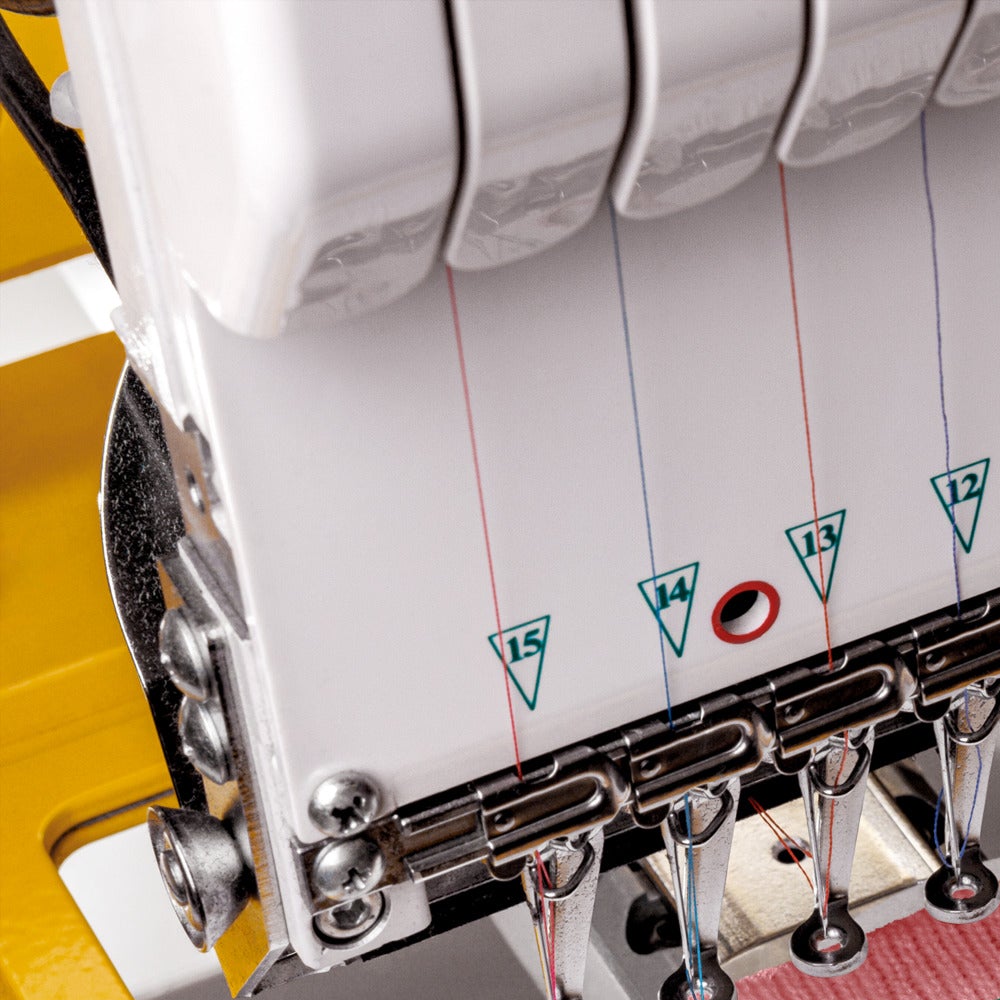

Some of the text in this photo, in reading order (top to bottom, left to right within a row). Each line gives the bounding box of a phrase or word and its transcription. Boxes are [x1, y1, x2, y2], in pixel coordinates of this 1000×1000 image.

[946, 472, 982, 507] 12
[800, 524, 838, 559] 13
[655, 577, 690, 610] 14
[505, 629, 543, 663] 15
